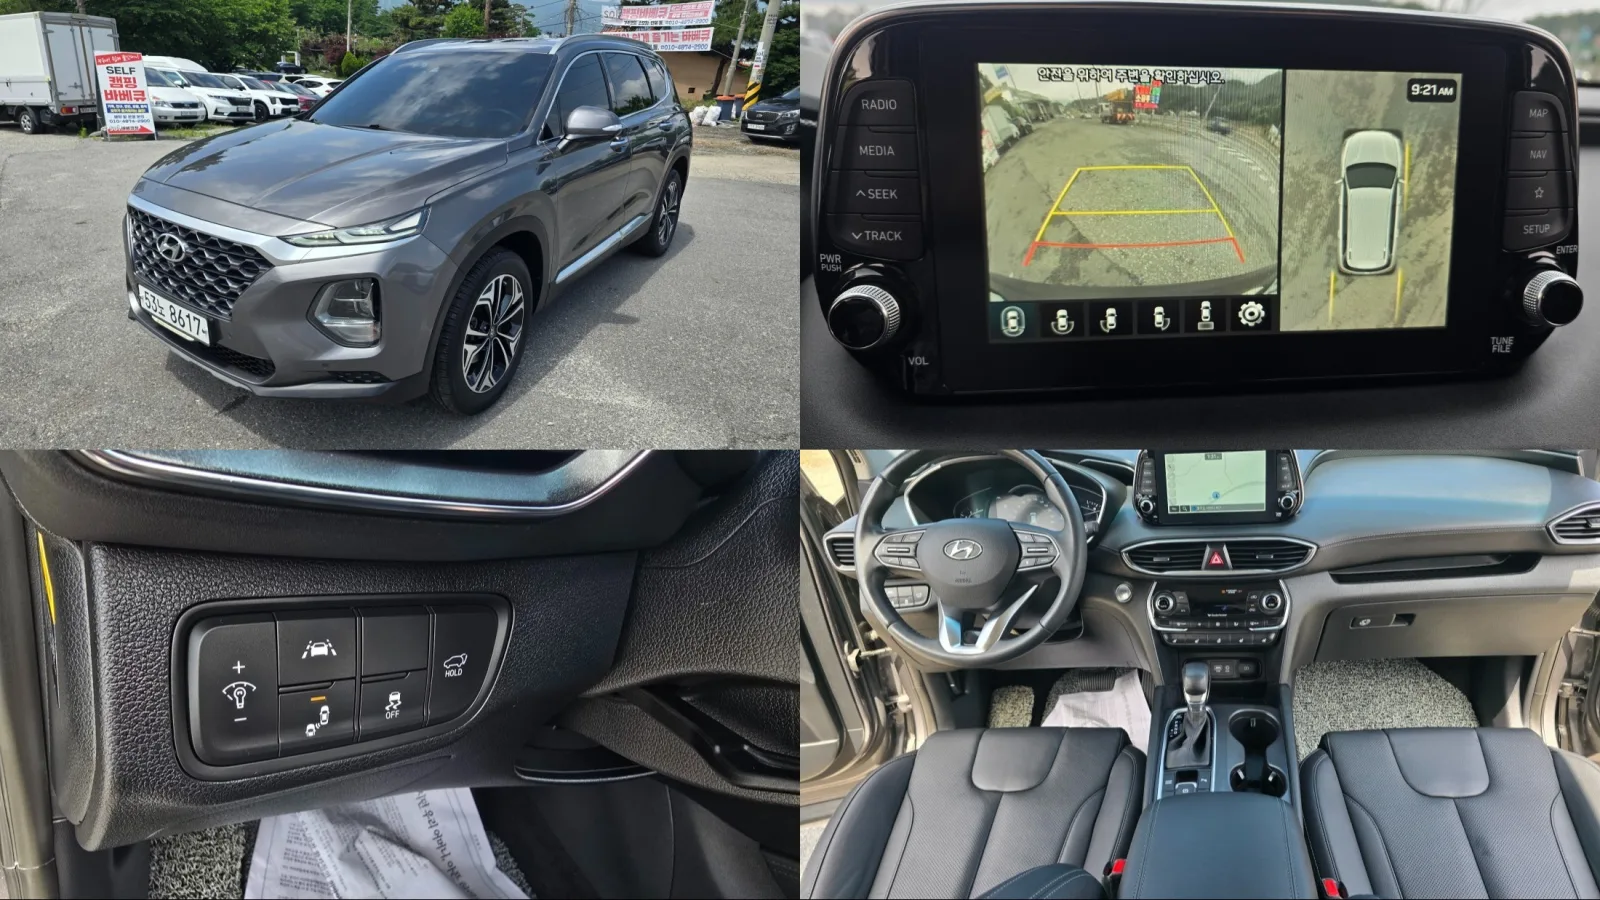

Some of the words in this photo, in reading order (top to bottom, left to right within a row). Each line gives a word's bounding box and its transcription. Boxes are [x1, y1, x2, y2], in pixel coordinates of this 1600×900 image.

[682, 30, 710, 42] 바베큐
[106, 66, 136, 75] SELF
[1037, 67, 1075, 82] 안전을
[1076, 68, 1112, 82] 위하여
[1115, 69, 1151, 83] 주변을
[1153, 69, 1226, 84] 확인하십시오.
[109, 76, 138, 88] 캠핑
[104, 90, 147, 101] 바베큐
[1411, 84, 1437, 96] 9:21
[1437, 87, 1454, 96] AM
[861, 99, 897, 110] RADIO
[1529, 109, 1548, 118] MAP
[859, 145, 895, 156] MEDIA
[1530, 149, 1548, 160] NAV
[868, 189, 898, 200] SEEK
[1523, 224, 1551, 235] SETUP
[864, 230, 903, 241] TRACK
[1556, 245, 1578, 255] ENTER
[820, 254, 842, 264] PWR
[821, 263, 842, 273] PUSH
[144, 291, 165, 317] 53노
[169, 305, 201, 335] 8617
[1490, 336, 1514, 346] TUNE
[1492, 344, 1511, 353] FILE
[908, 357, 929, 366] VOL
[445, 668, 462, 678] HOLD
[385, 710, 400, 720] OFF
[422, 810, 438, 829] 우리
